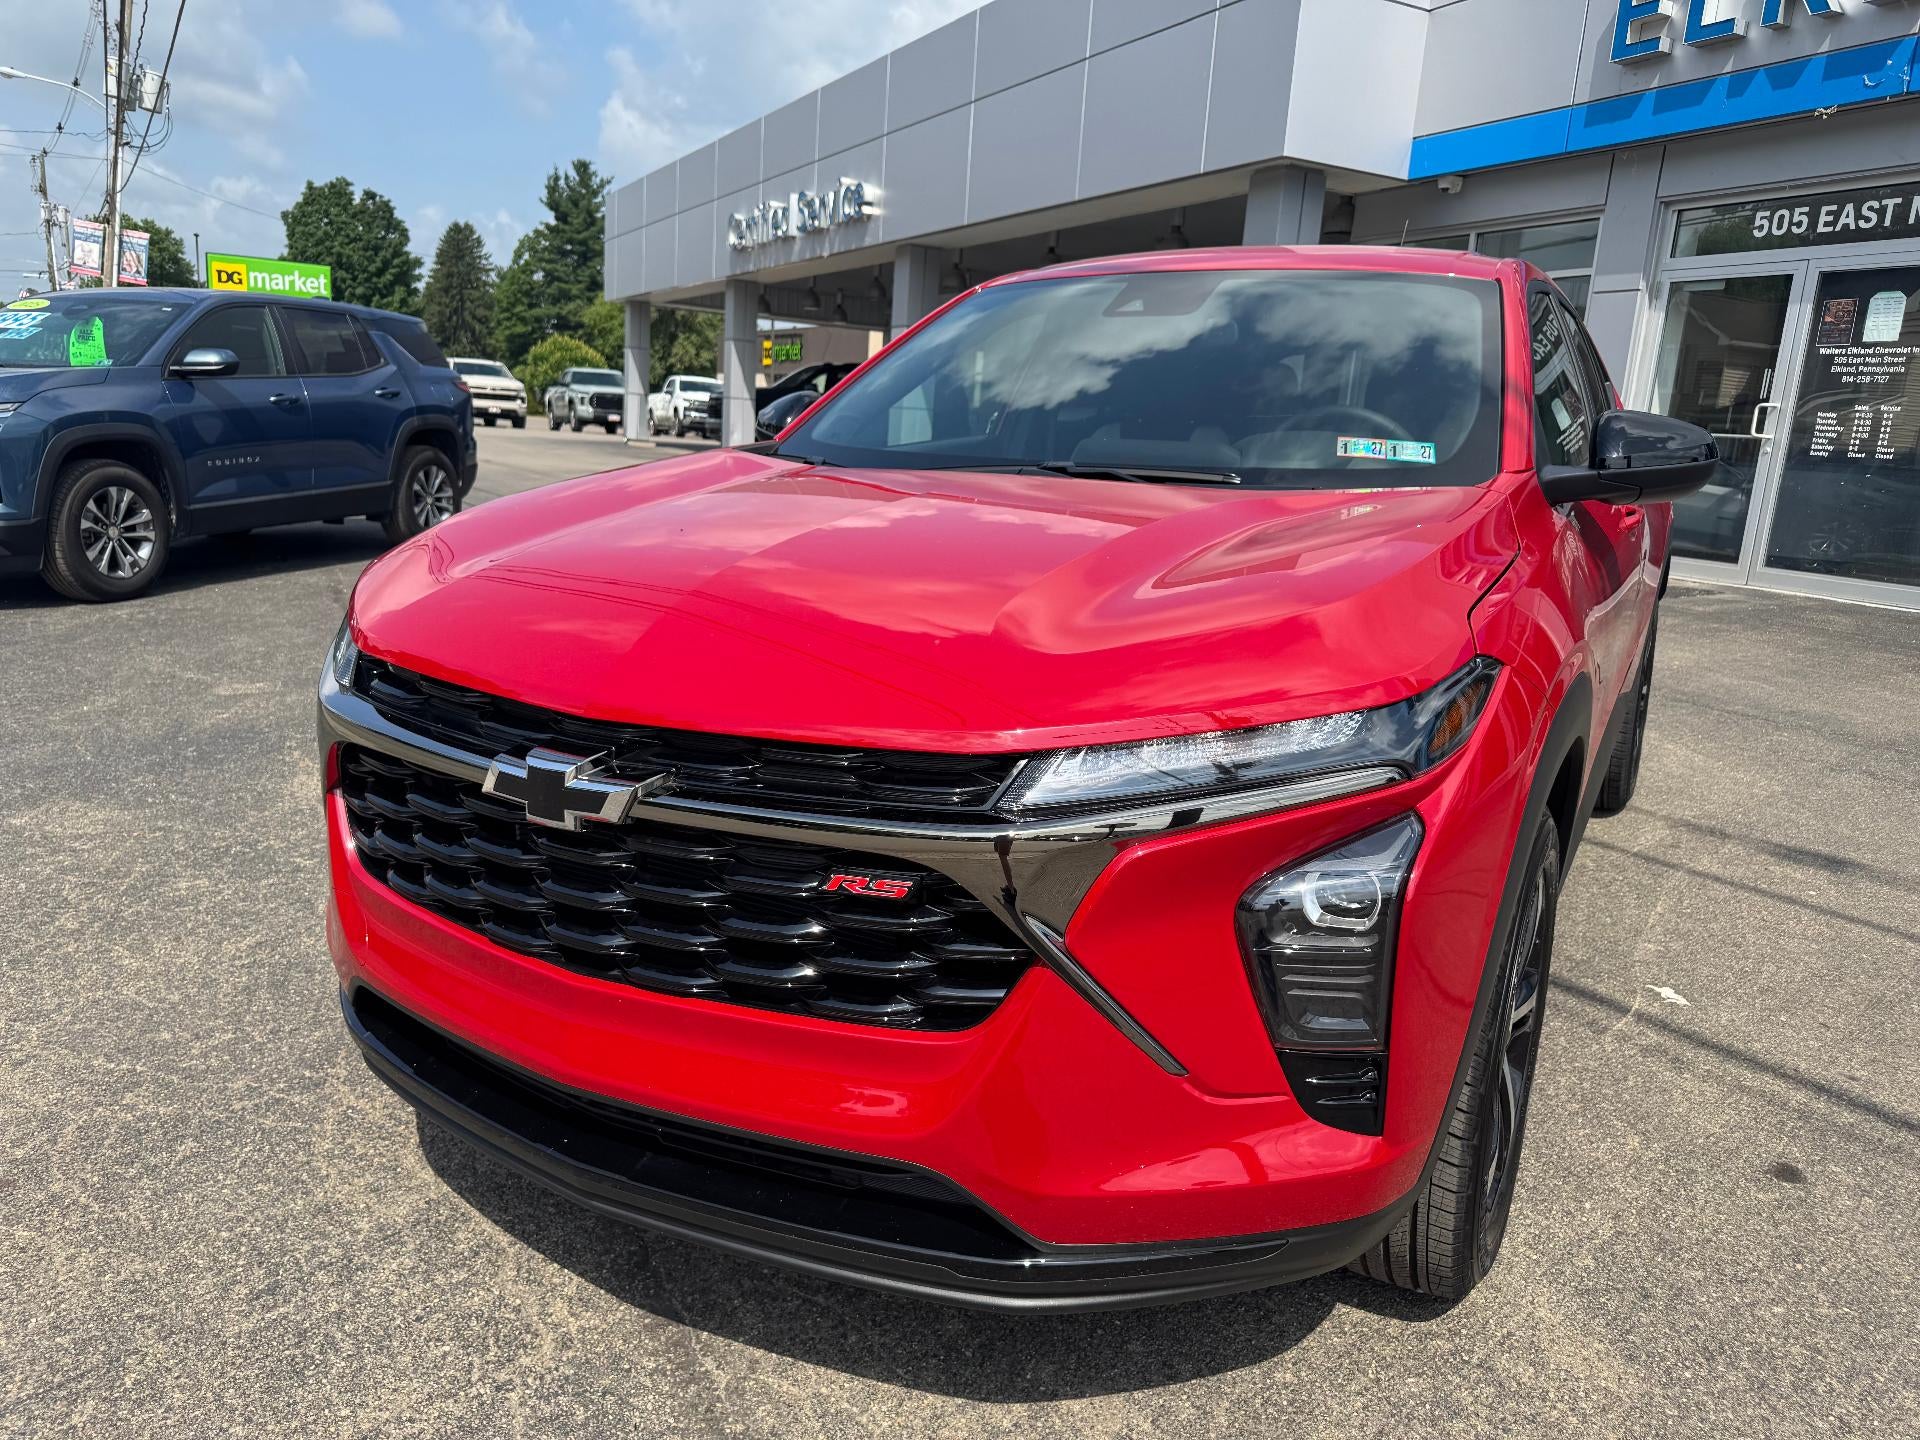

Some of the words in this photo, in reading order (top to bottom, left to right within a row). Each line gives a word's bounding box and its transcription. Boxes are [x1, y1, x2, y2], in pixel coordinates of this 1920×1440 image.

[1752, 206, 1810, 238] 505
[1816, 197, 1903, 233] EAST
[216, 269, 243, 285] DG
[248, 270, 328, 295] market
[1847, 346, 1874, 354] Elkland
[1875, 346, 1911, 354] Chevrolet
[1833, 356, 1847, 364] 505
[1848, 356, 1864, 364] East
[1883, 355, 1906, 363] Street
[1858, 365, 1905, 374] Pennsylvania
[1371, 441, 1383, 456] 27
[1420, 445, 1432, 460] 27
[825, 874, 914, 898] RS
